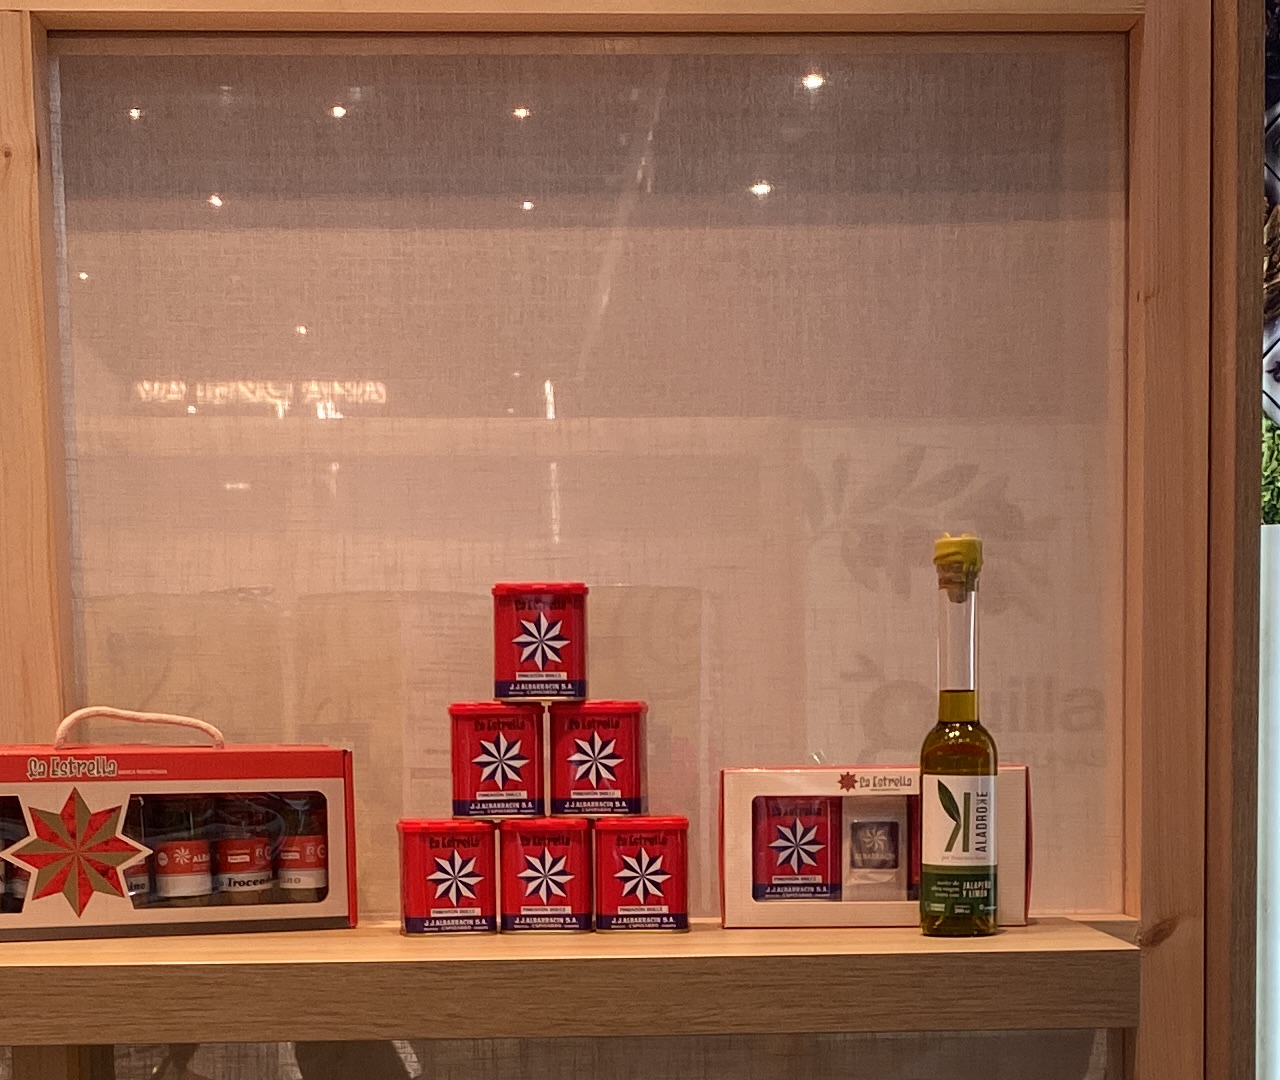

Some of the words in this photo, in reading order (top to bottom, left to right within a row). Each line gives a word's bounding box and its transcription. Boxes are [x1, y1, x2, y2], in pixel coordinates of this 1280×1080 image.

[27, 757, 47, 779] La
[50, 756, 117, 778] Estrella
[873, 776, 912, 787] Estrella
